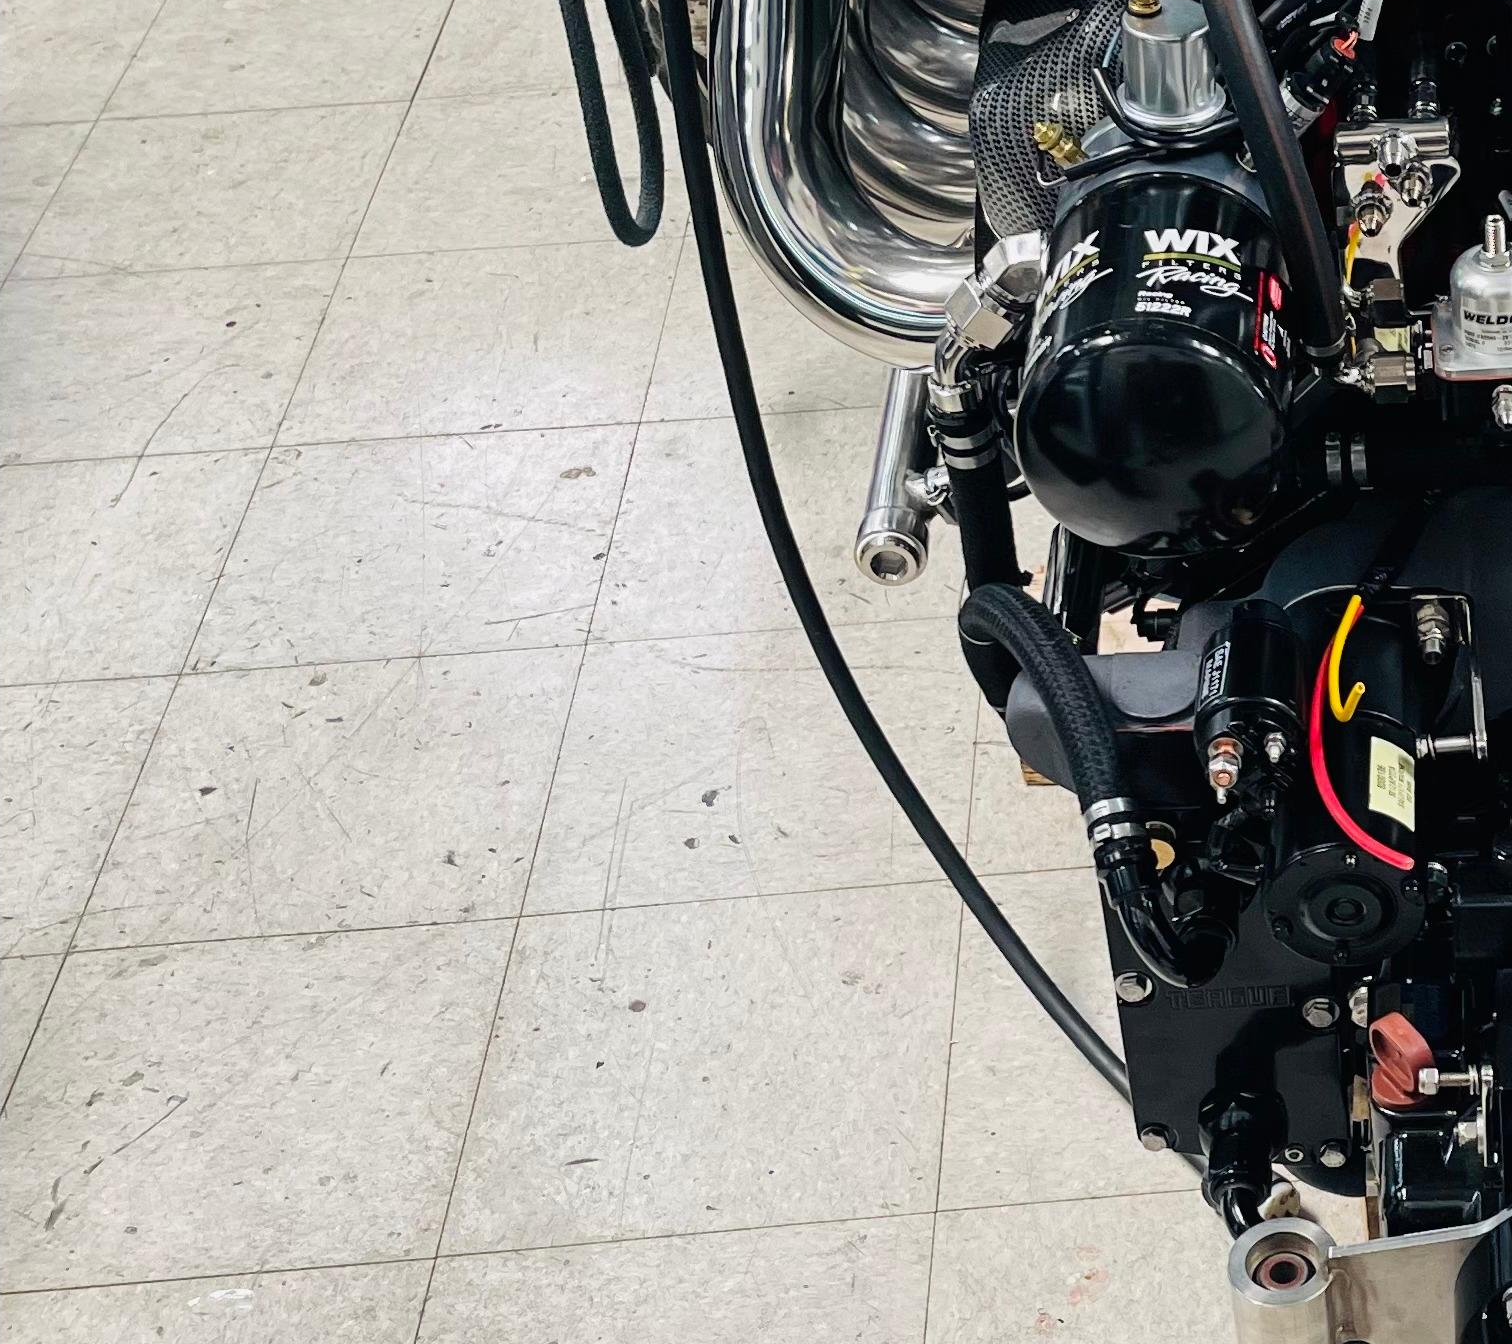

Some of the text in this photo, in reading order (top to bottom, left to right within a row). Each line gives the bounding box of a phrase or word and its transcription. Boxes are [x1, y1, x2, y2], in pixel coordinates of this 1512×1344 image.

[1143, 228, 1242, 264] WIX
[1136, 265, 1254, 303] Racing
[1141, 259, 1243, 281] FILTERS
